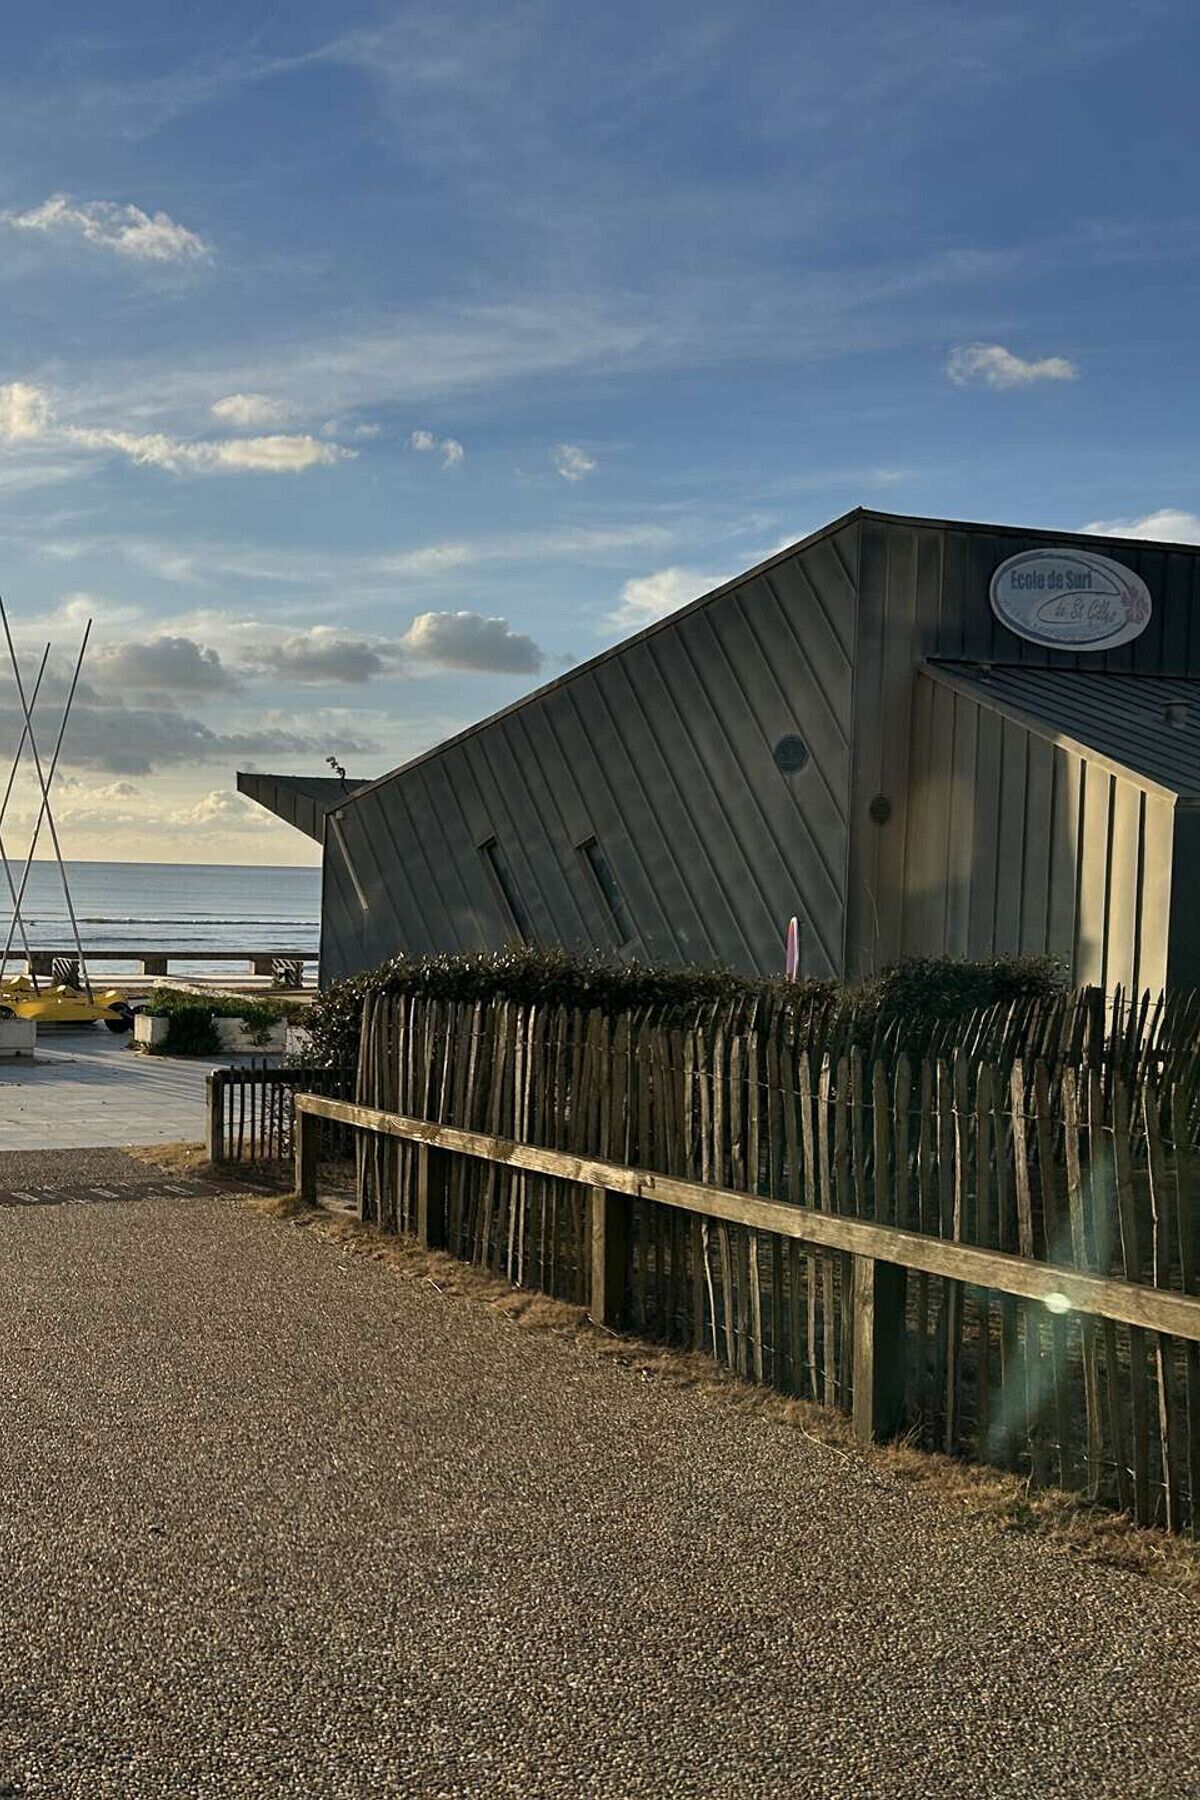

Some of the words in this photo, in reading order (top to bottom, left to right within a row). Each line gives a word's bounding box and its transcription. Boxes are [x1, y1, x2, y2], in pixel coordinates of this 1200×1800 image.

[1010, 569, 1045, 590] Ecole
[1047, 570, 1063, 590] de
[1066, 570, 1093, 589] Surf
